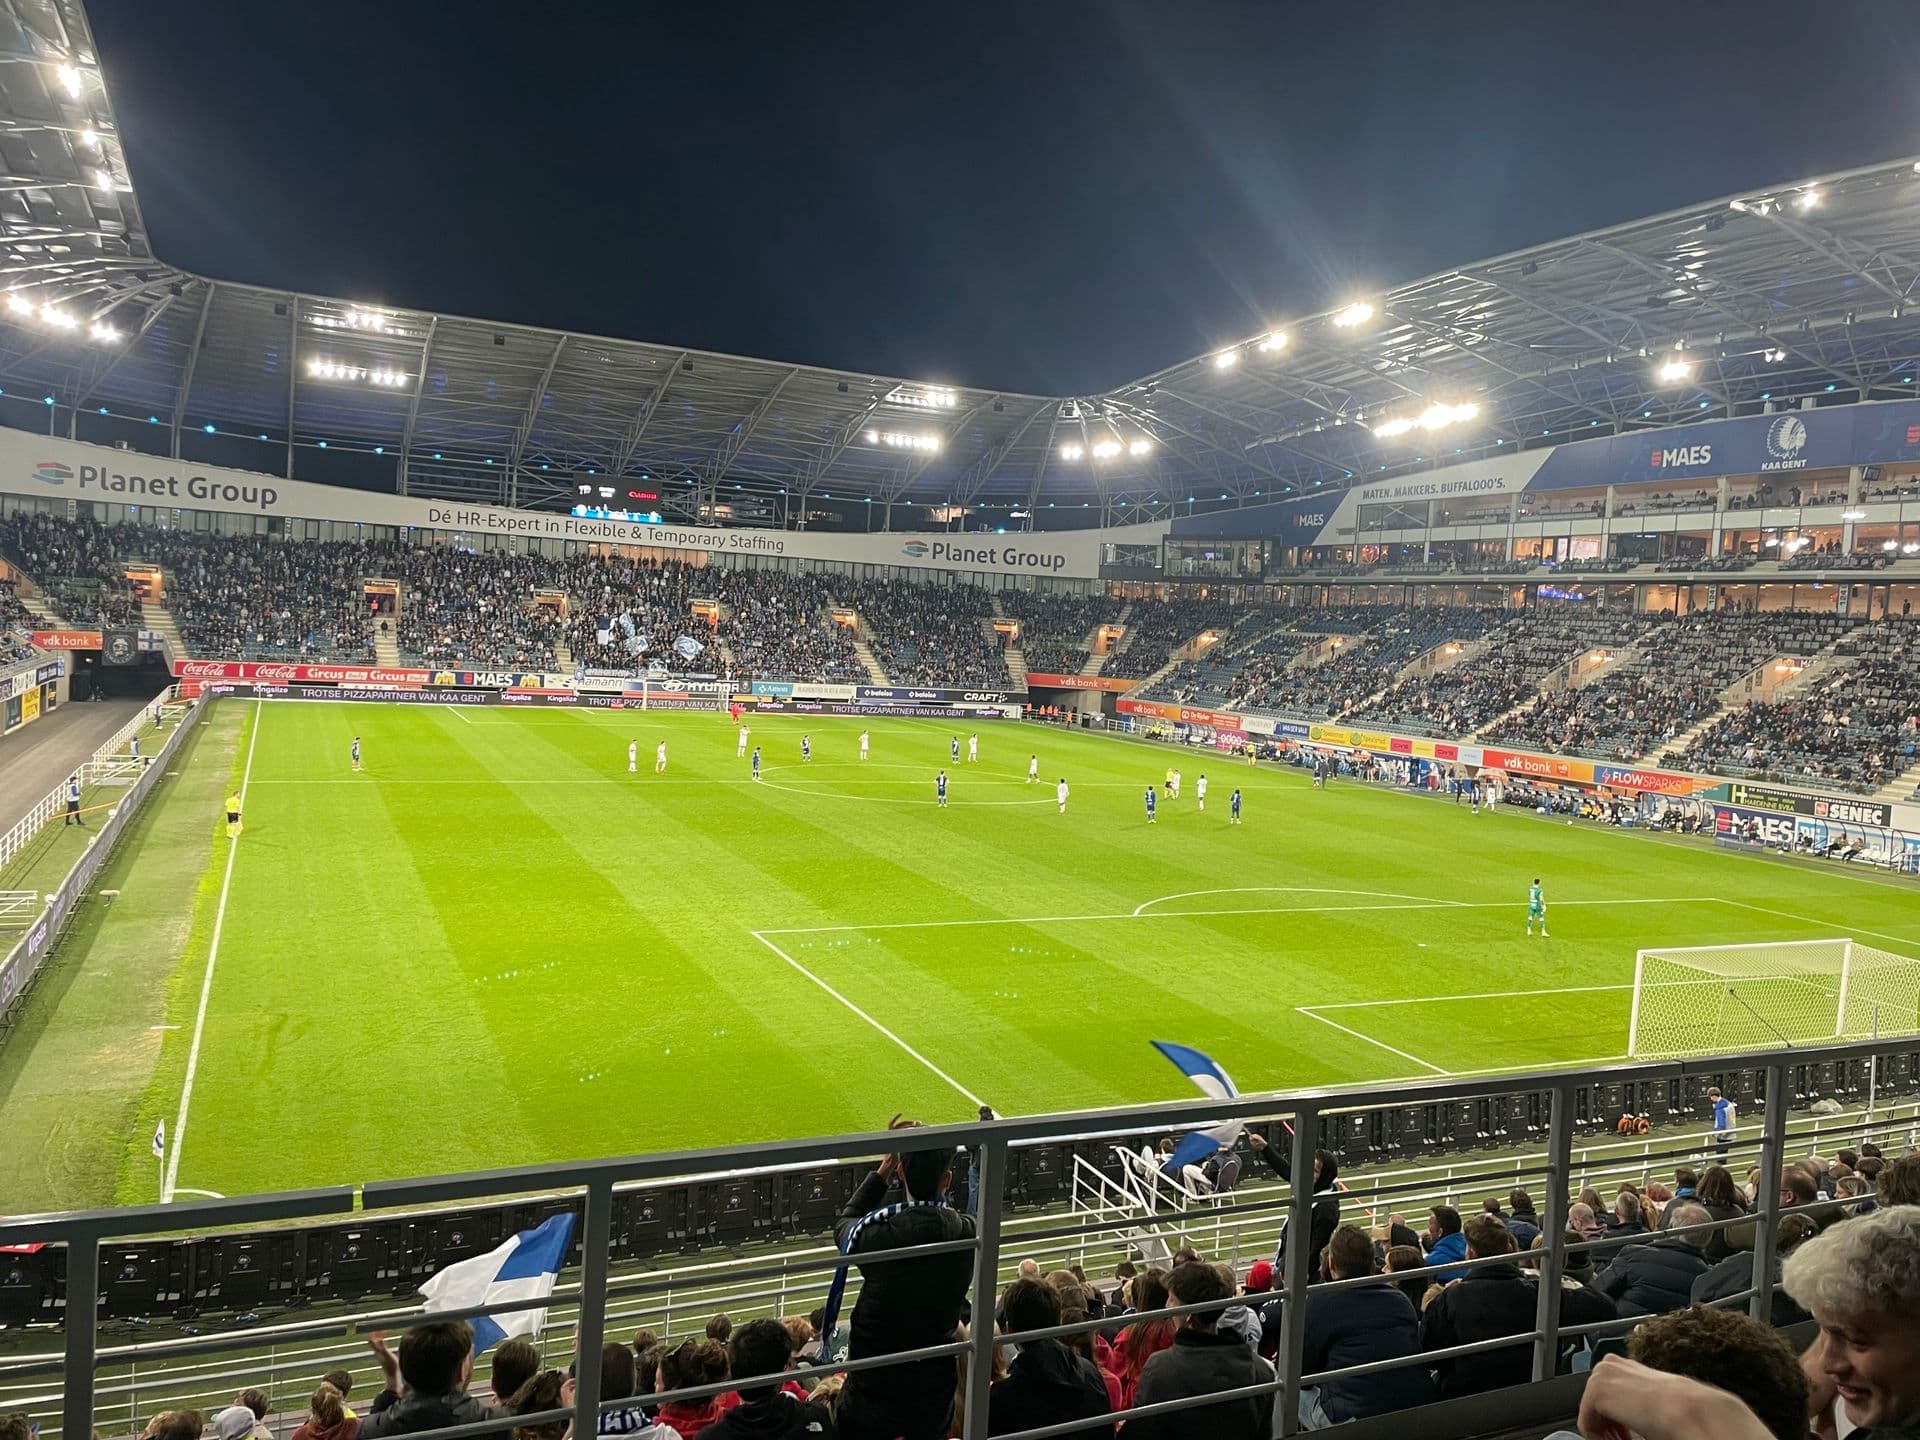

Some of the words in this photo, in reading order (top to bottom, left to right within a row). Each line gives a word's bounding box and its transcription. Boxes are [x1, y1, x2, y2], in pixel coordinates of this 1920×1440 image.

[1662, 444, 1711, 468] MAES
[1761, 461, 1781, 471] KAA
[1782, 459, 1807, 469] GENT
[79, 465, 179, 497] Planet
[187, 476, 278, 509] Group
[1362, 488, 1392, 500] MATEN.
[1394, 484, 1439, 498] MAKKERS.
[628, 491, 657, 499] Canon
[1300, 513, 1324, 527] MAES
[429, 508, 452, 523] Dé
[457, 511, 541, 532] HR-Expert
[545, 518, 559, 533] in
[565, 521, 626, 537] Flexible
[630, 526, 642, 539] &
[647, 527, 726, 548] Temporary
[730, 534, 784, 553] Staffing
[932, 542, 996, 565] Planet
[1002, 548, 1066, 572] Group
[43, 634, 61, 646] vdk
[63, 634, 89, 646] bank
[307, 668, 344, 680] Circus
[370, 670, 405, 682] Circus
[474, 673, 513, 686] MAES
[1060, 677, 1076, 686] vdk
[1077, 678, 1098, 688] bank
[301, 688, 341, 698] TROTSE
[343, 689, 416, 701] PIZZAPARTNER
[418, 693, 437, 701] VAN
[439, 693, 458, 702] KAA
[460, 694, 486, 703] GENT
[964, 692, 998, 702] CRAFT
[832, 705, 860, 713] TROTSE
[861, 707, 914, 715] PIZZAPARTNER
[930, 708, 945, 716] KAA
[946, 709, 965, 717] GENT
[1220, 733, 1242, 746] odoo
[1504, 756, 1522, 769] vdk
[1525, 758, 1551, 773] bank
[1829, 803, 1883, 825] SENEC
[1731, 812, 1794, 842] MAES
